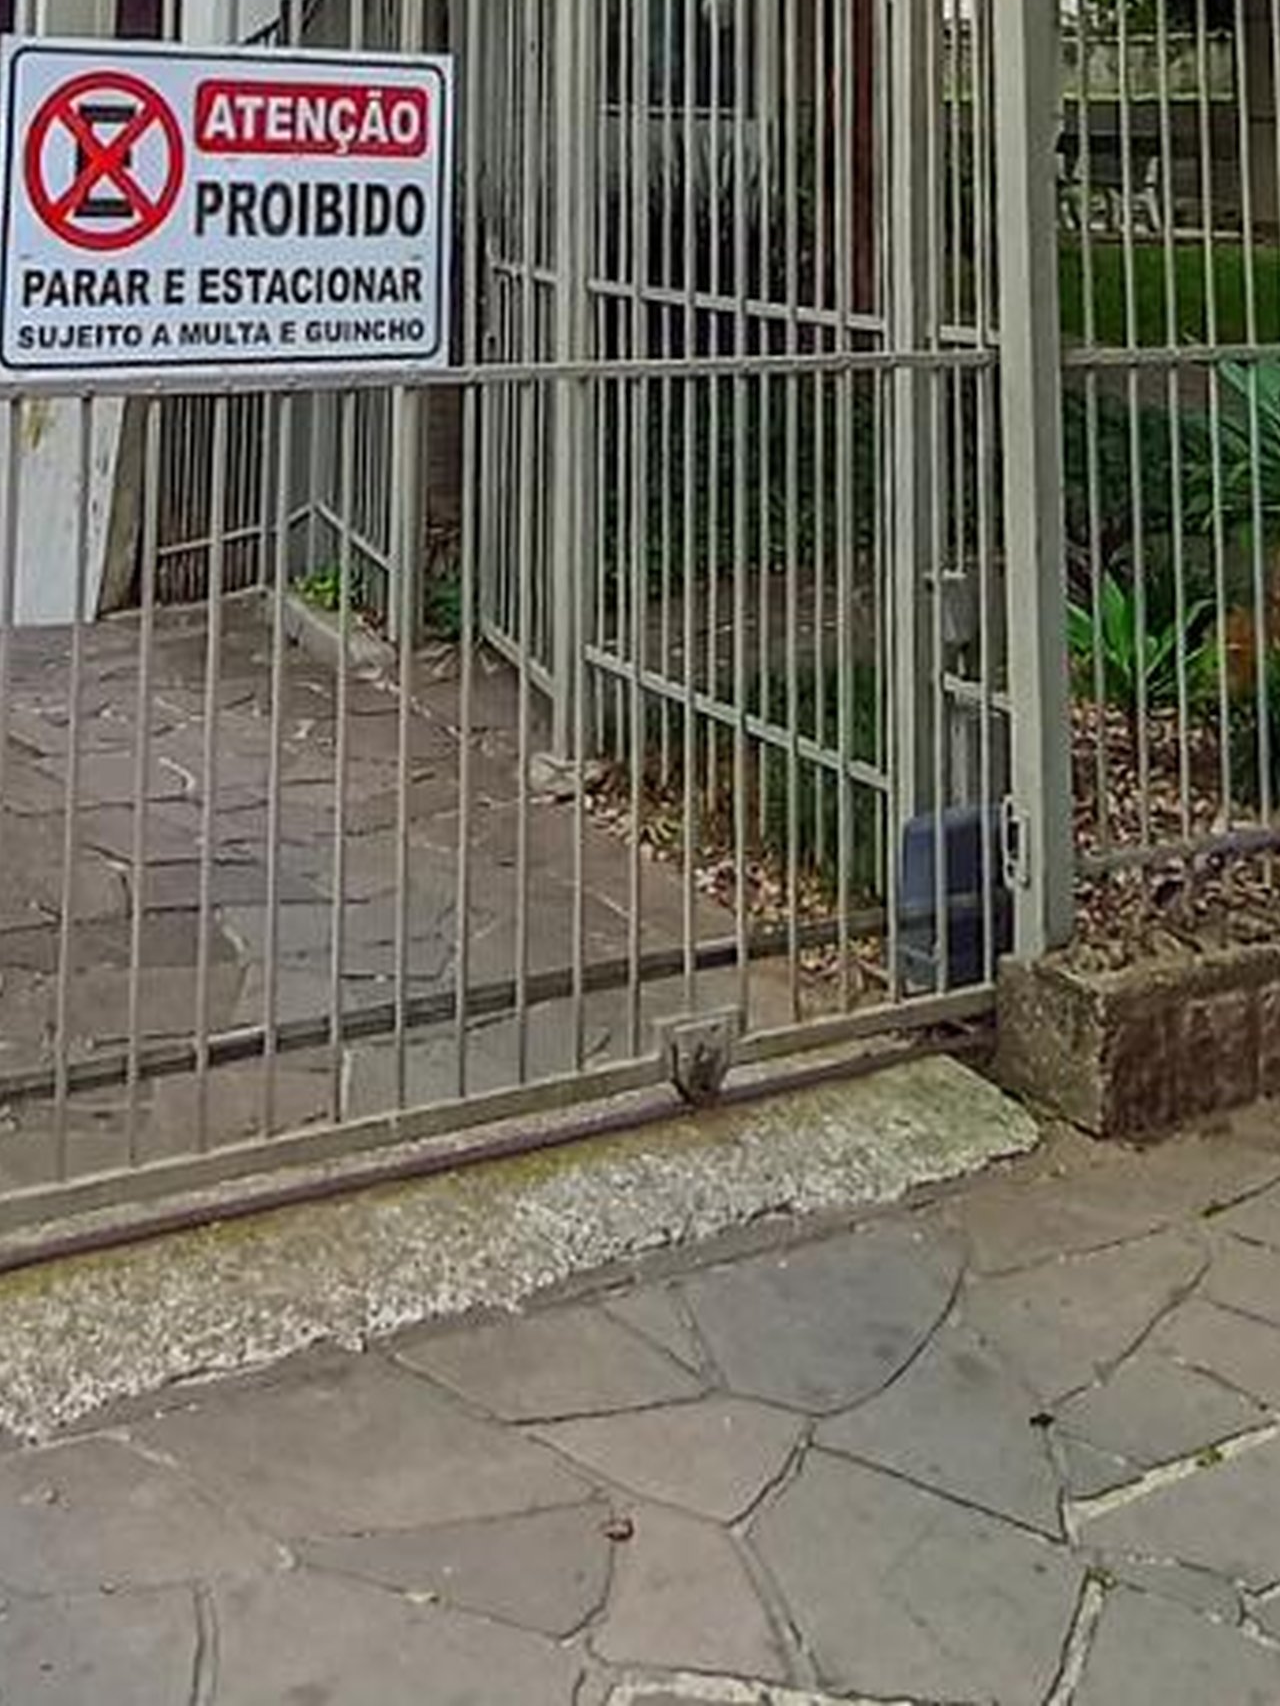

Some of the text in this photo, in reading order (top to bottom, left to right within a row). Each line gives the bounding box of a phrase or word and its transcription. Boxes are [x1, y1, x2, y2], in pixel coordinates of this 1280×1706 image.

[202, 89, 419, 153] ATENÇÃO
[195, 182, 426, 237] PROIBIDO
[22, 267, 423, 308] PARAR E ESTACIONAR
[18, 318, 425, 349] SUJEITO A MULTA E GUINCHO
